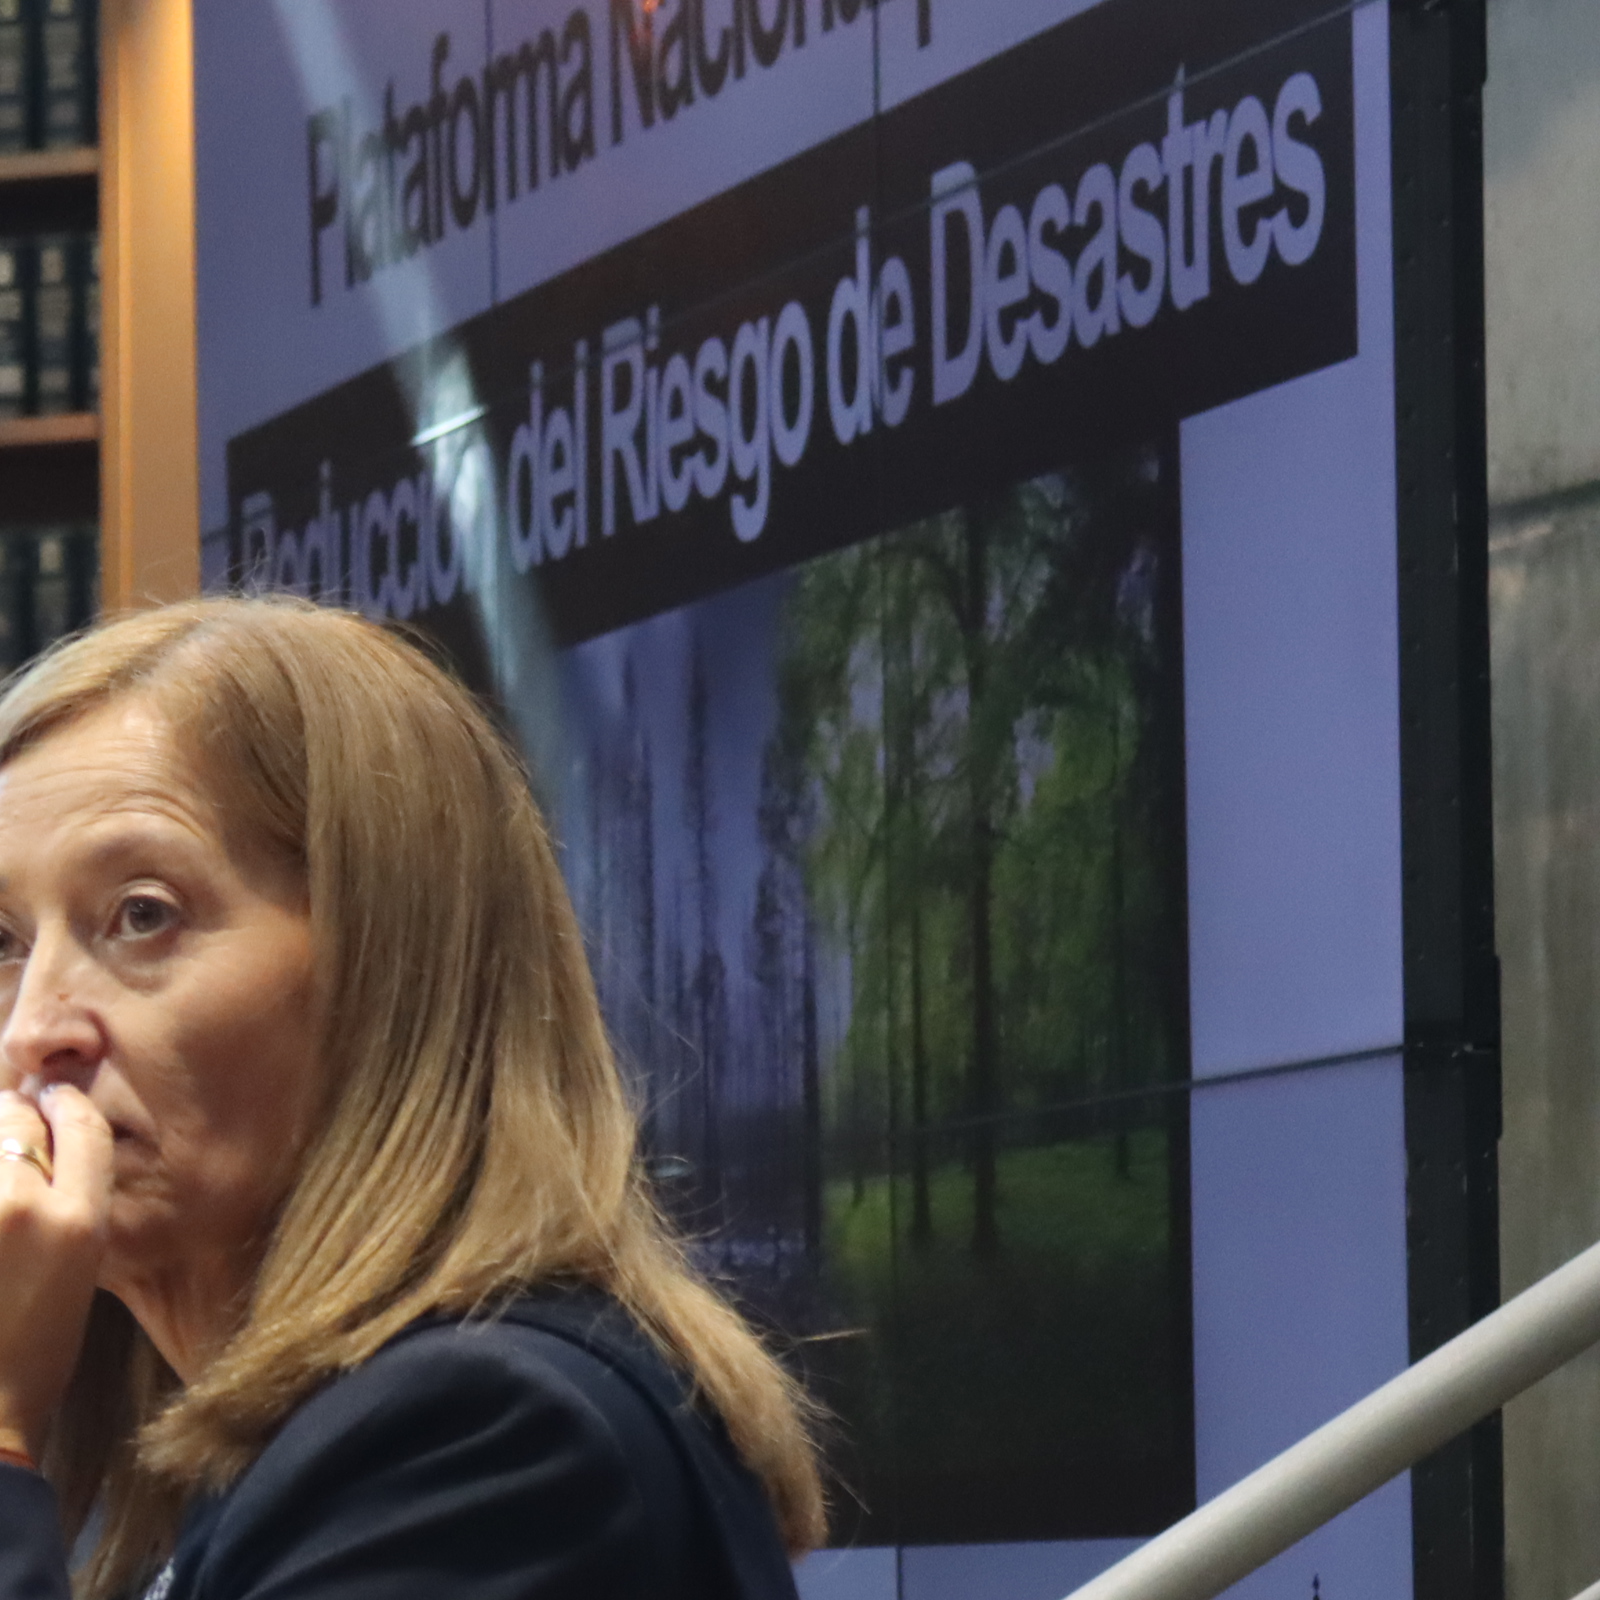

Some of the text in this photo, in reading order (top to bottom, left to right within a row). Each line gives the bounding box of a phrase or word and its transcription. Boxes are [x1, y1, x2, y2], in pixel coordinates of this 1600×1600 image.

[306, 8, 597, 309] Plataforma
[508, 338, 590, 575] del
[601, 302, 814, 542] Riesgo
[826, 204, 916, 446] de
[930, 62, 1327, 407] Desastres
